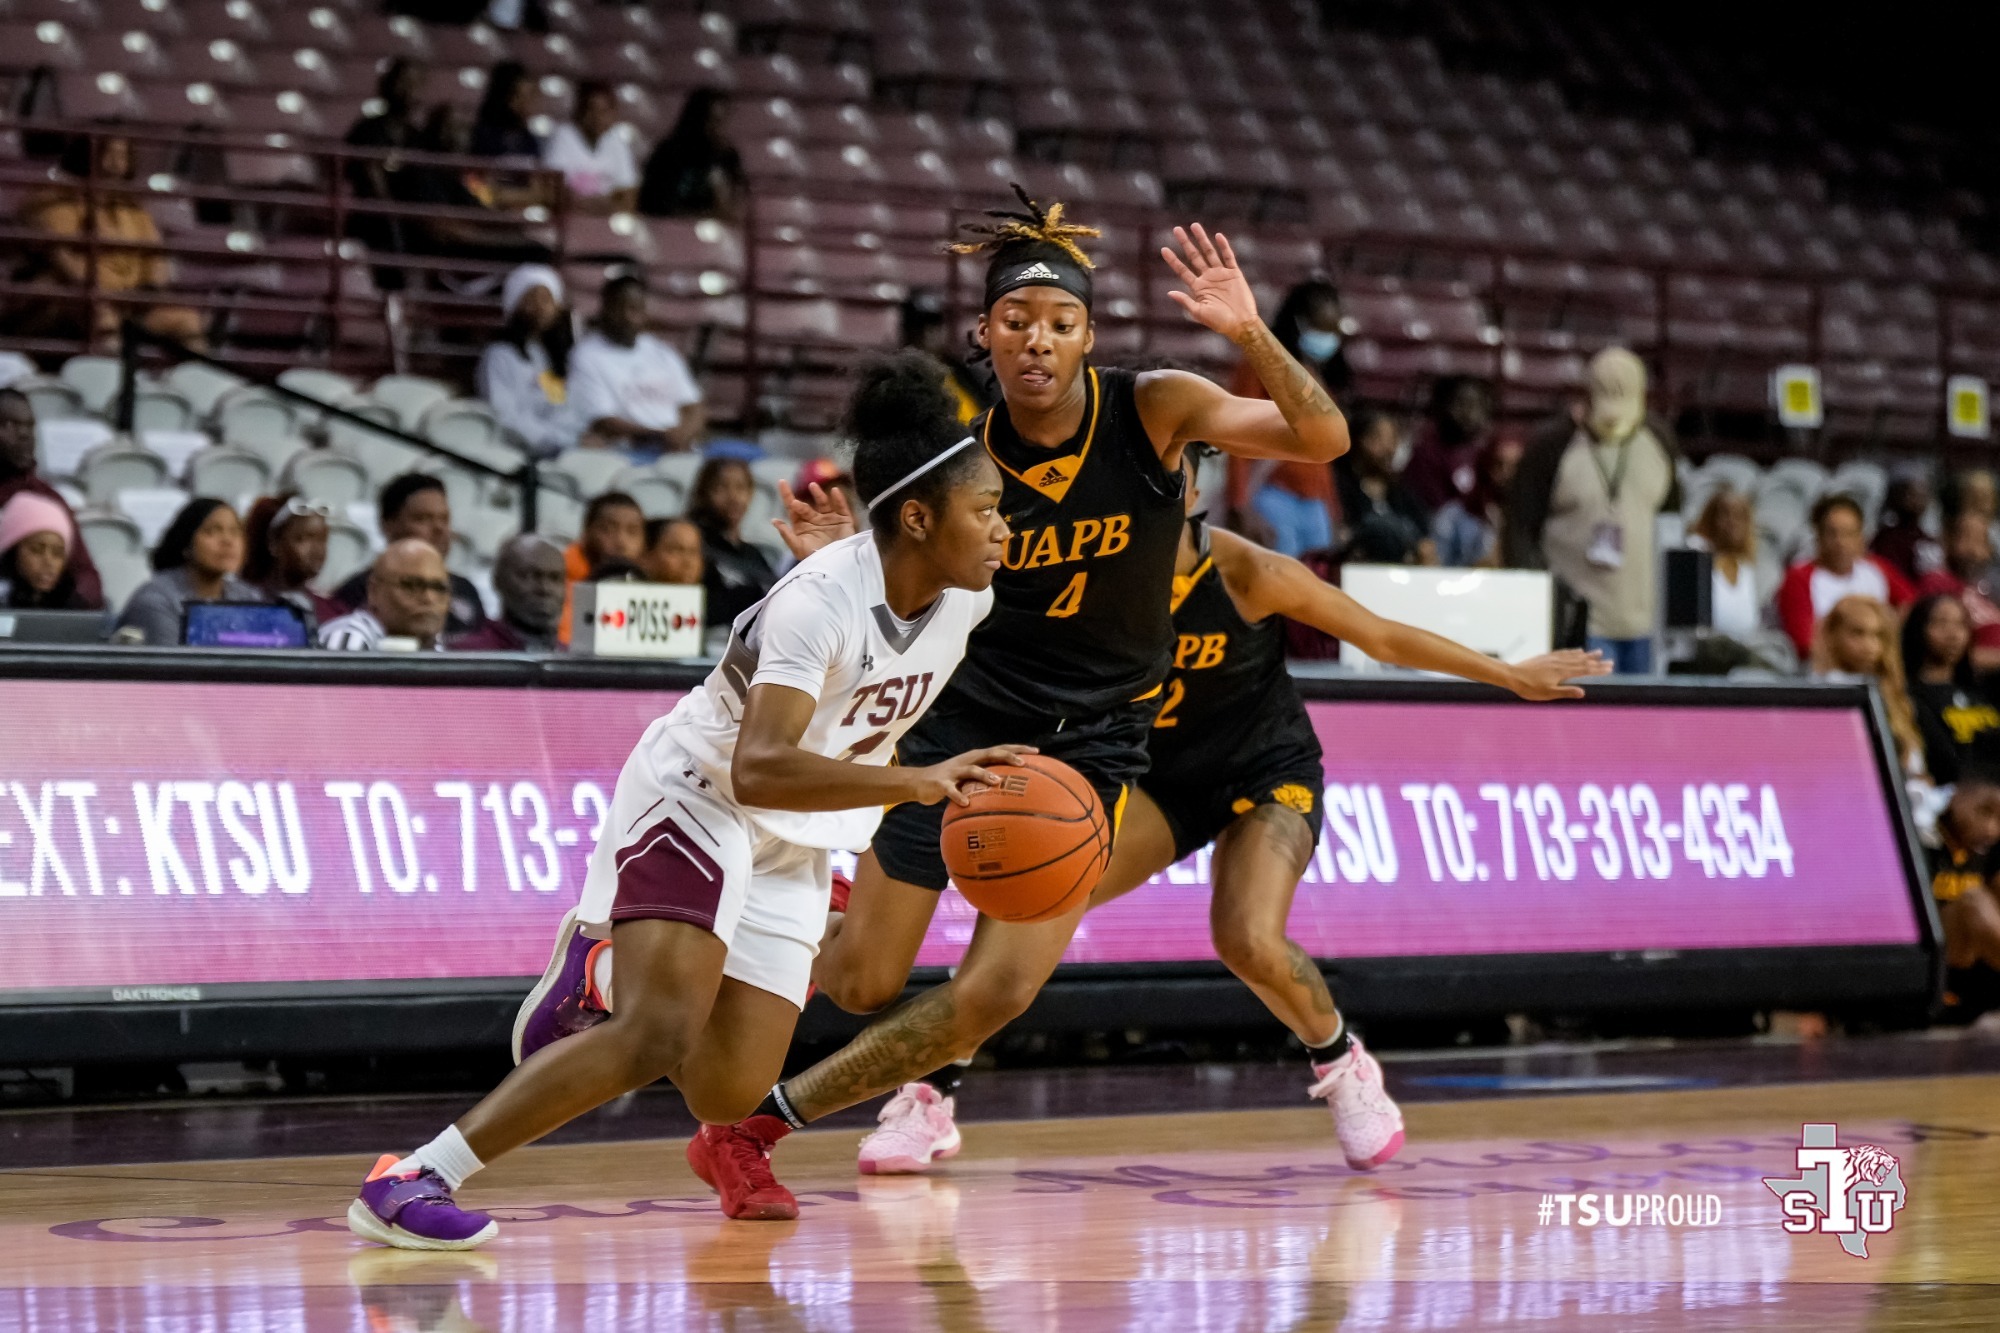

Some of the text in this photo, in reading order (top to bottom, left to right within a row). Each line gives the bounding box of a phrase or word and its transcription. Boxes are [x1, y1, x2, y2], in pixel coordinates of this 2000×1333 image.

[1000, 513, 1132, 571] UAPB
[627, 599, 670, 641] POSS
[1045, 571, 1088, 618] 4
[840, 671, 934, 727] TSU
[1153, 677, 1185, 728] 2
[132, 780, 312, 897] KTSU
[325, 781, 438, 893] TO:
[1479, 784, 1794, 881] 713-313-4354
